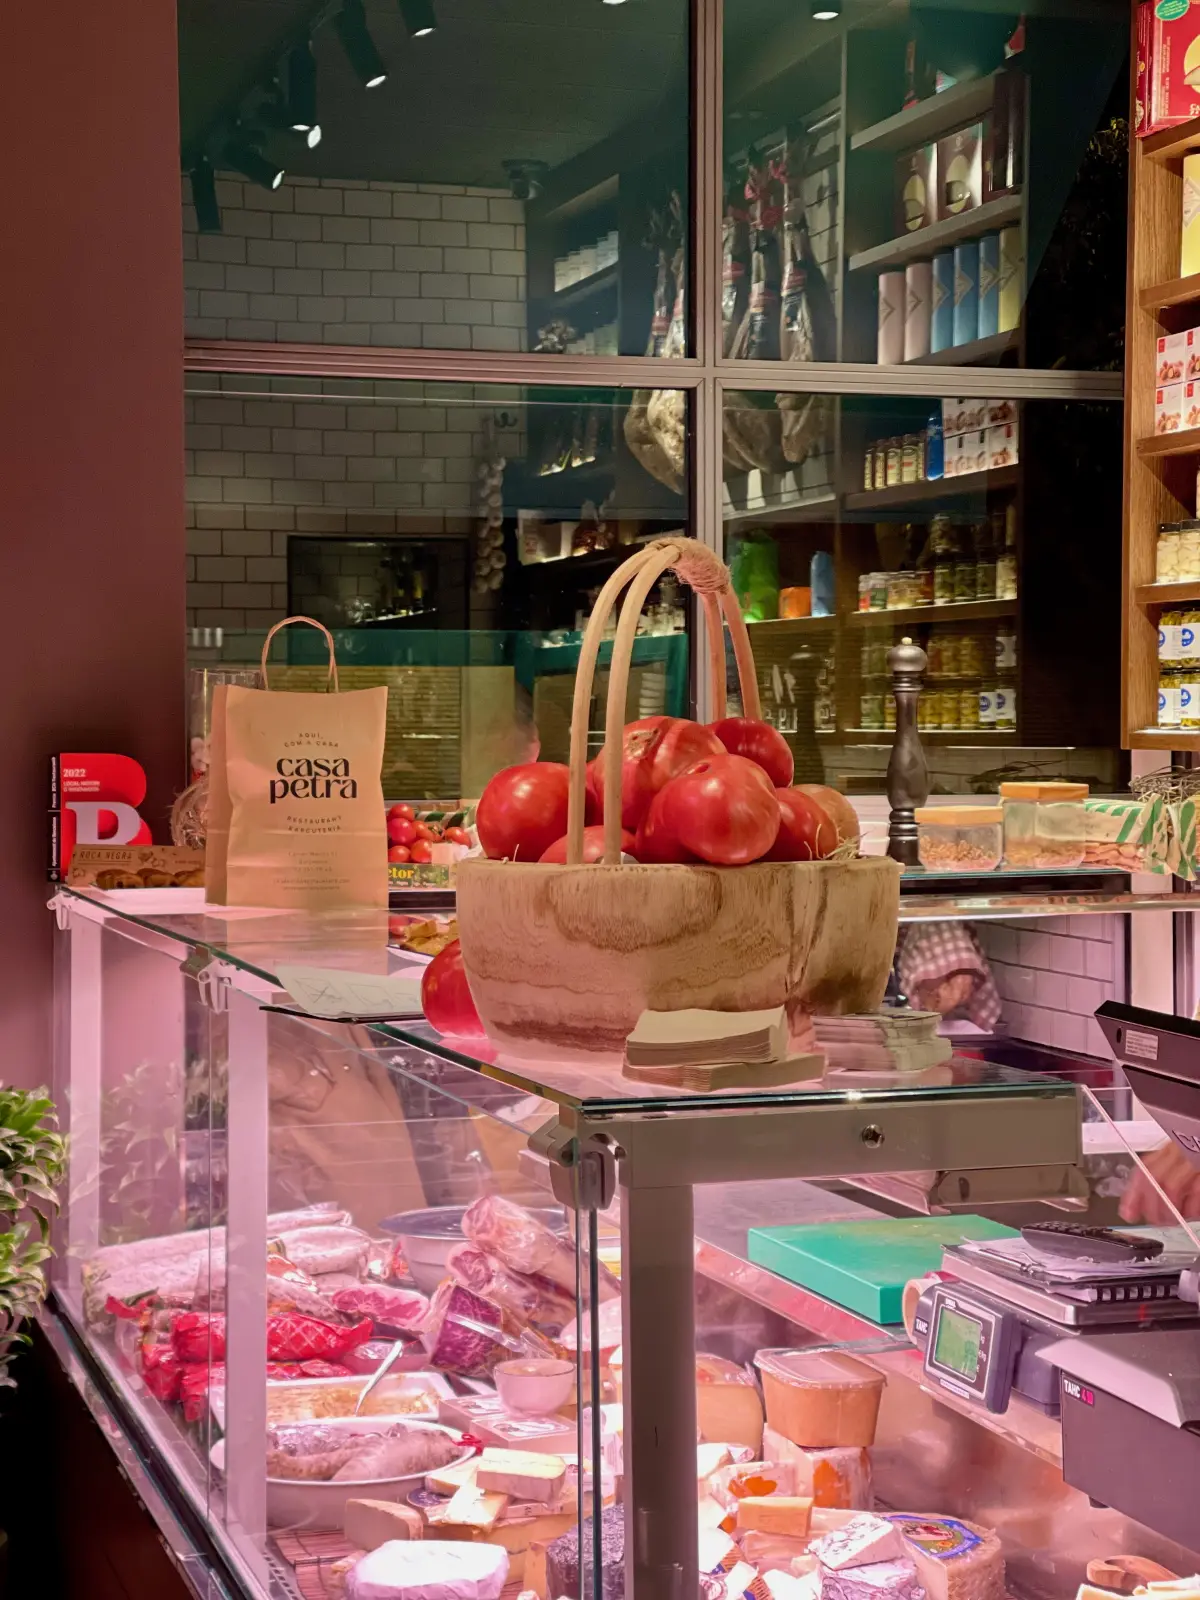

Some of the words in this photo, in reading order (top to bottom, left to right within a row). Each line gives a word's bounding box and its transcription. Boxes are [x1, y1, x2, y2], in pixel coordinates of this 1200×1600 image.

[63, 768, 86, 777] 2022
[276, 757, 350, 777] casa
[269, 773, 357, 804] petra
[79, 851, 101, 860] ROCA
[106, 851, 132, 860] NEGRA
